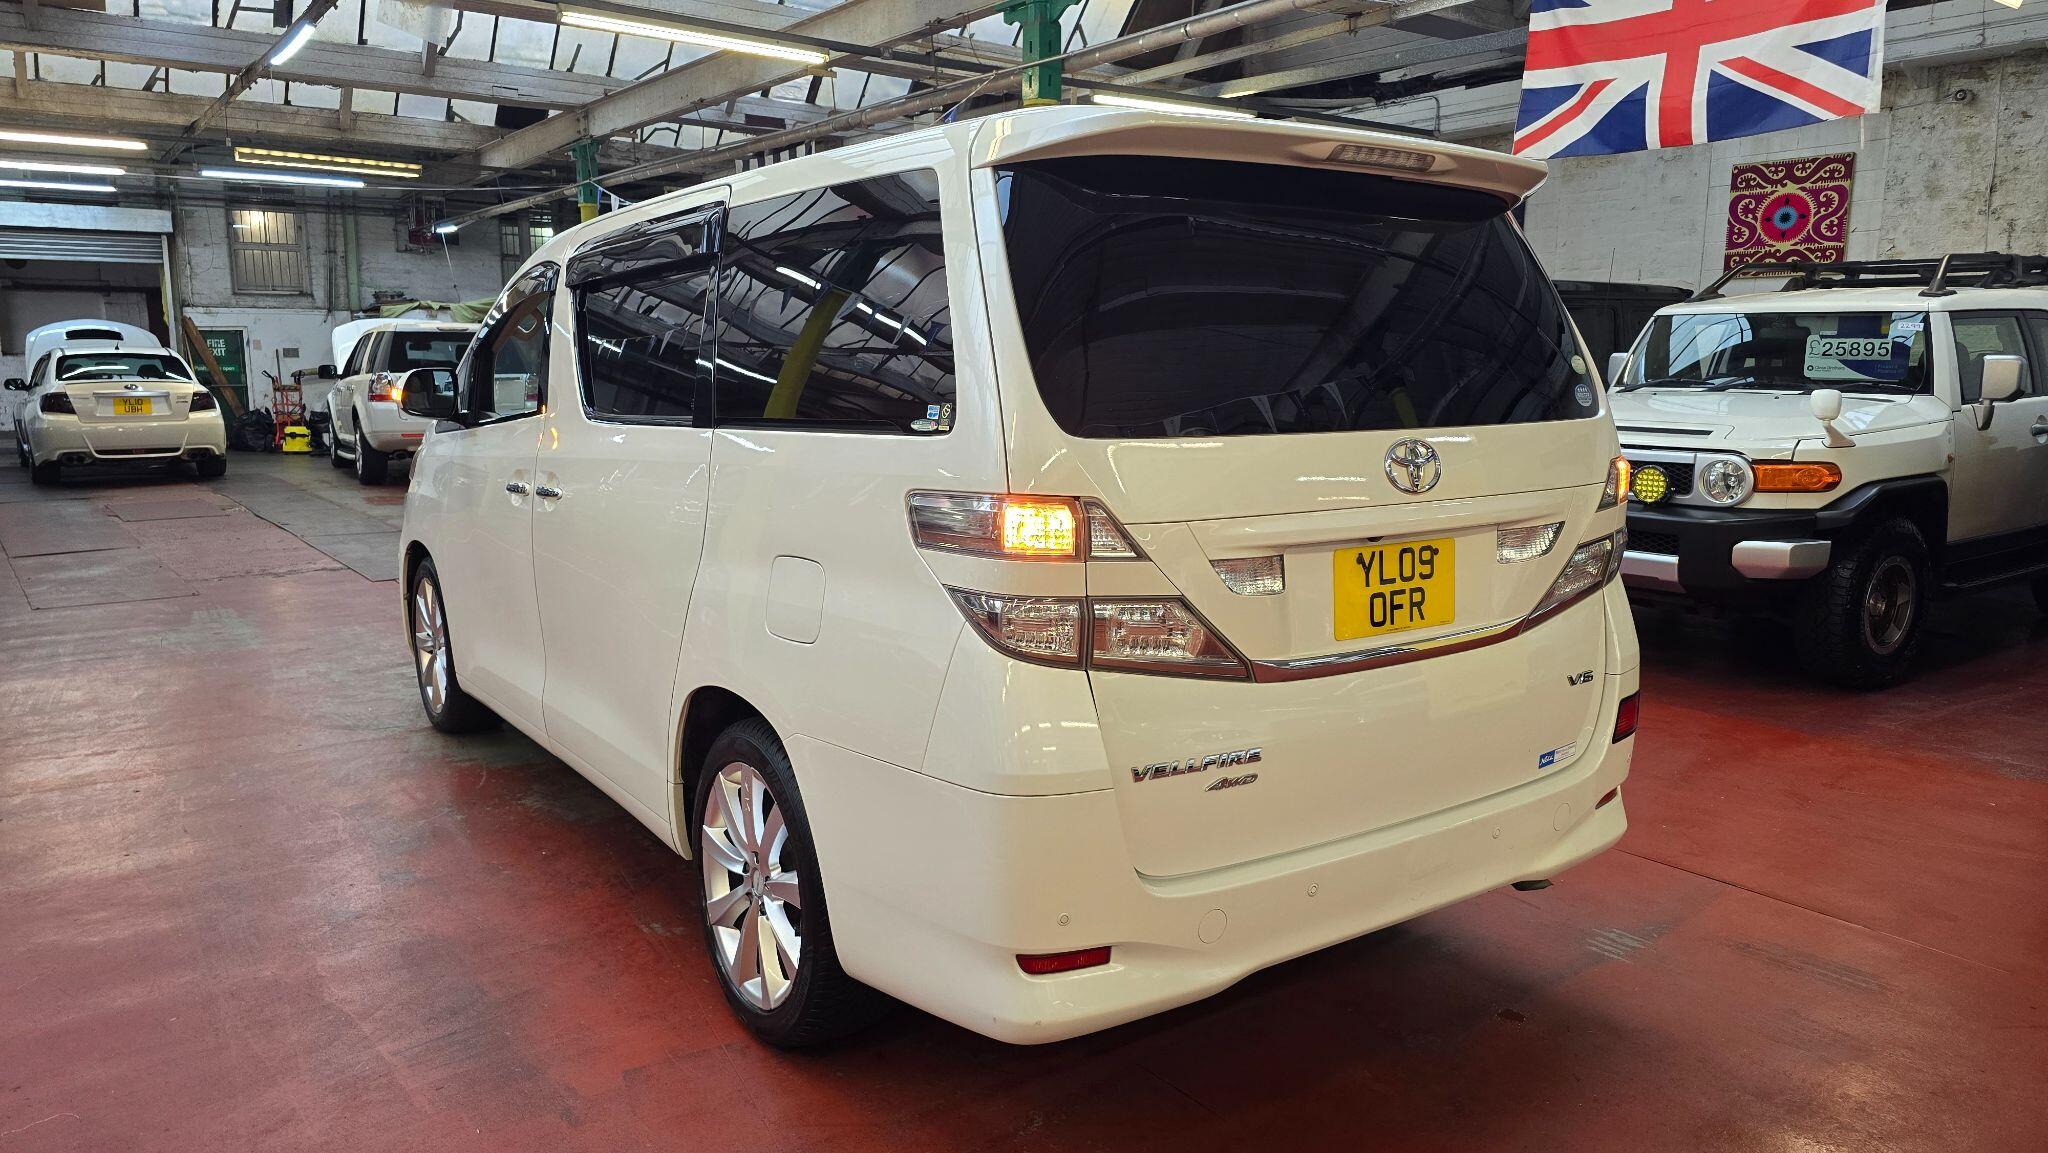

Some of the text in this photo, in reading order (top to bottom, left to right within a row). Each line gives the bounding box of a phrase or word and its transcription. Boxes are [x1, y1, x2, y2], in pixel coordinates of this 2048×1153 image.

[207, 339, 226, 348] FIRE
[1809, 340, 1890, 357] £25895
[1358, 545, 1435, 588] YL09
[1369, 586, 1426, 628] OFR
[1567, 669, 1594, 686] V6
[1131, 747, 1262, 783] VELLFIRE
[1204, 773, 1259, 792] 4WD
